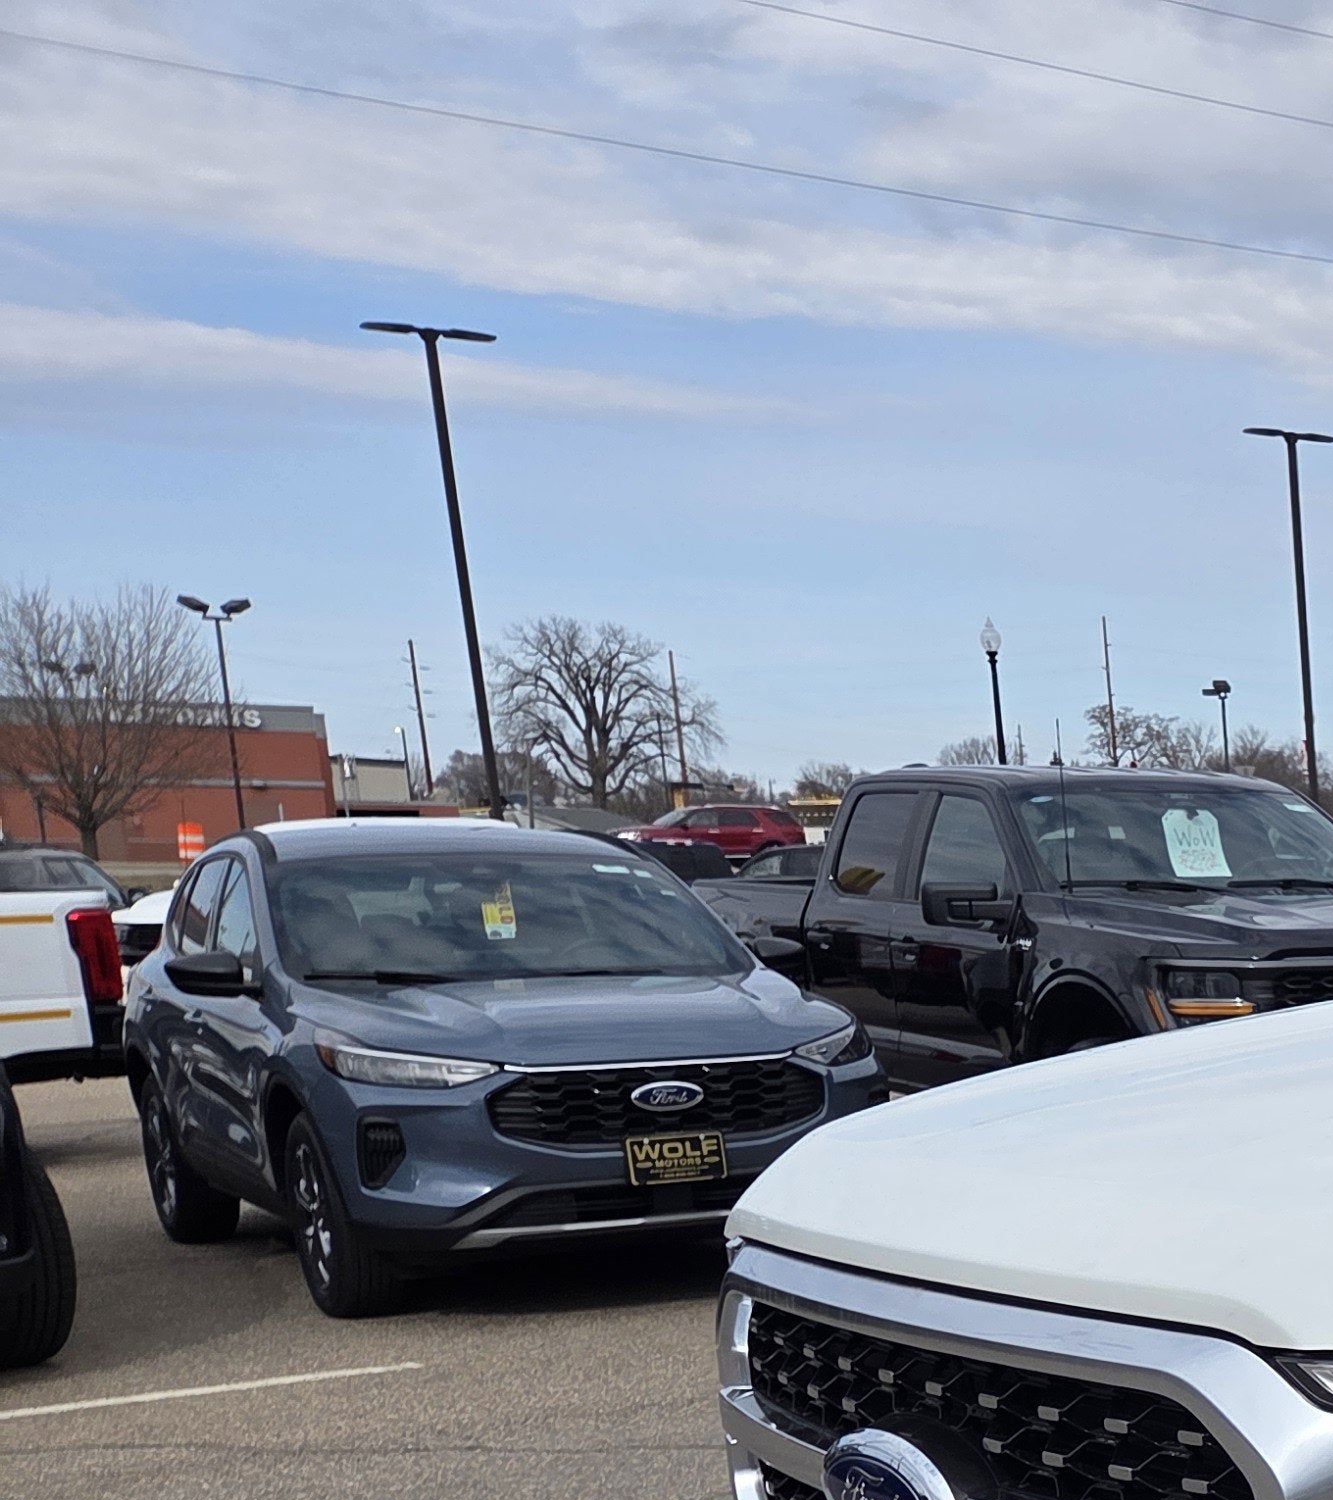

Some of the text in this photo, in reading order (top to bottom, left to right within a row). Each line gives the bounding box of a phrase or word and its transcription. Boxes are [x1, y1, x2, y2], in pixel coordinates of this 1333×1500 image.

[649, 1088, 689, 1105] Ford
[632, 1138, 718, 1161] WOLF
[655, 1157, 702, 1168] MOTORS
